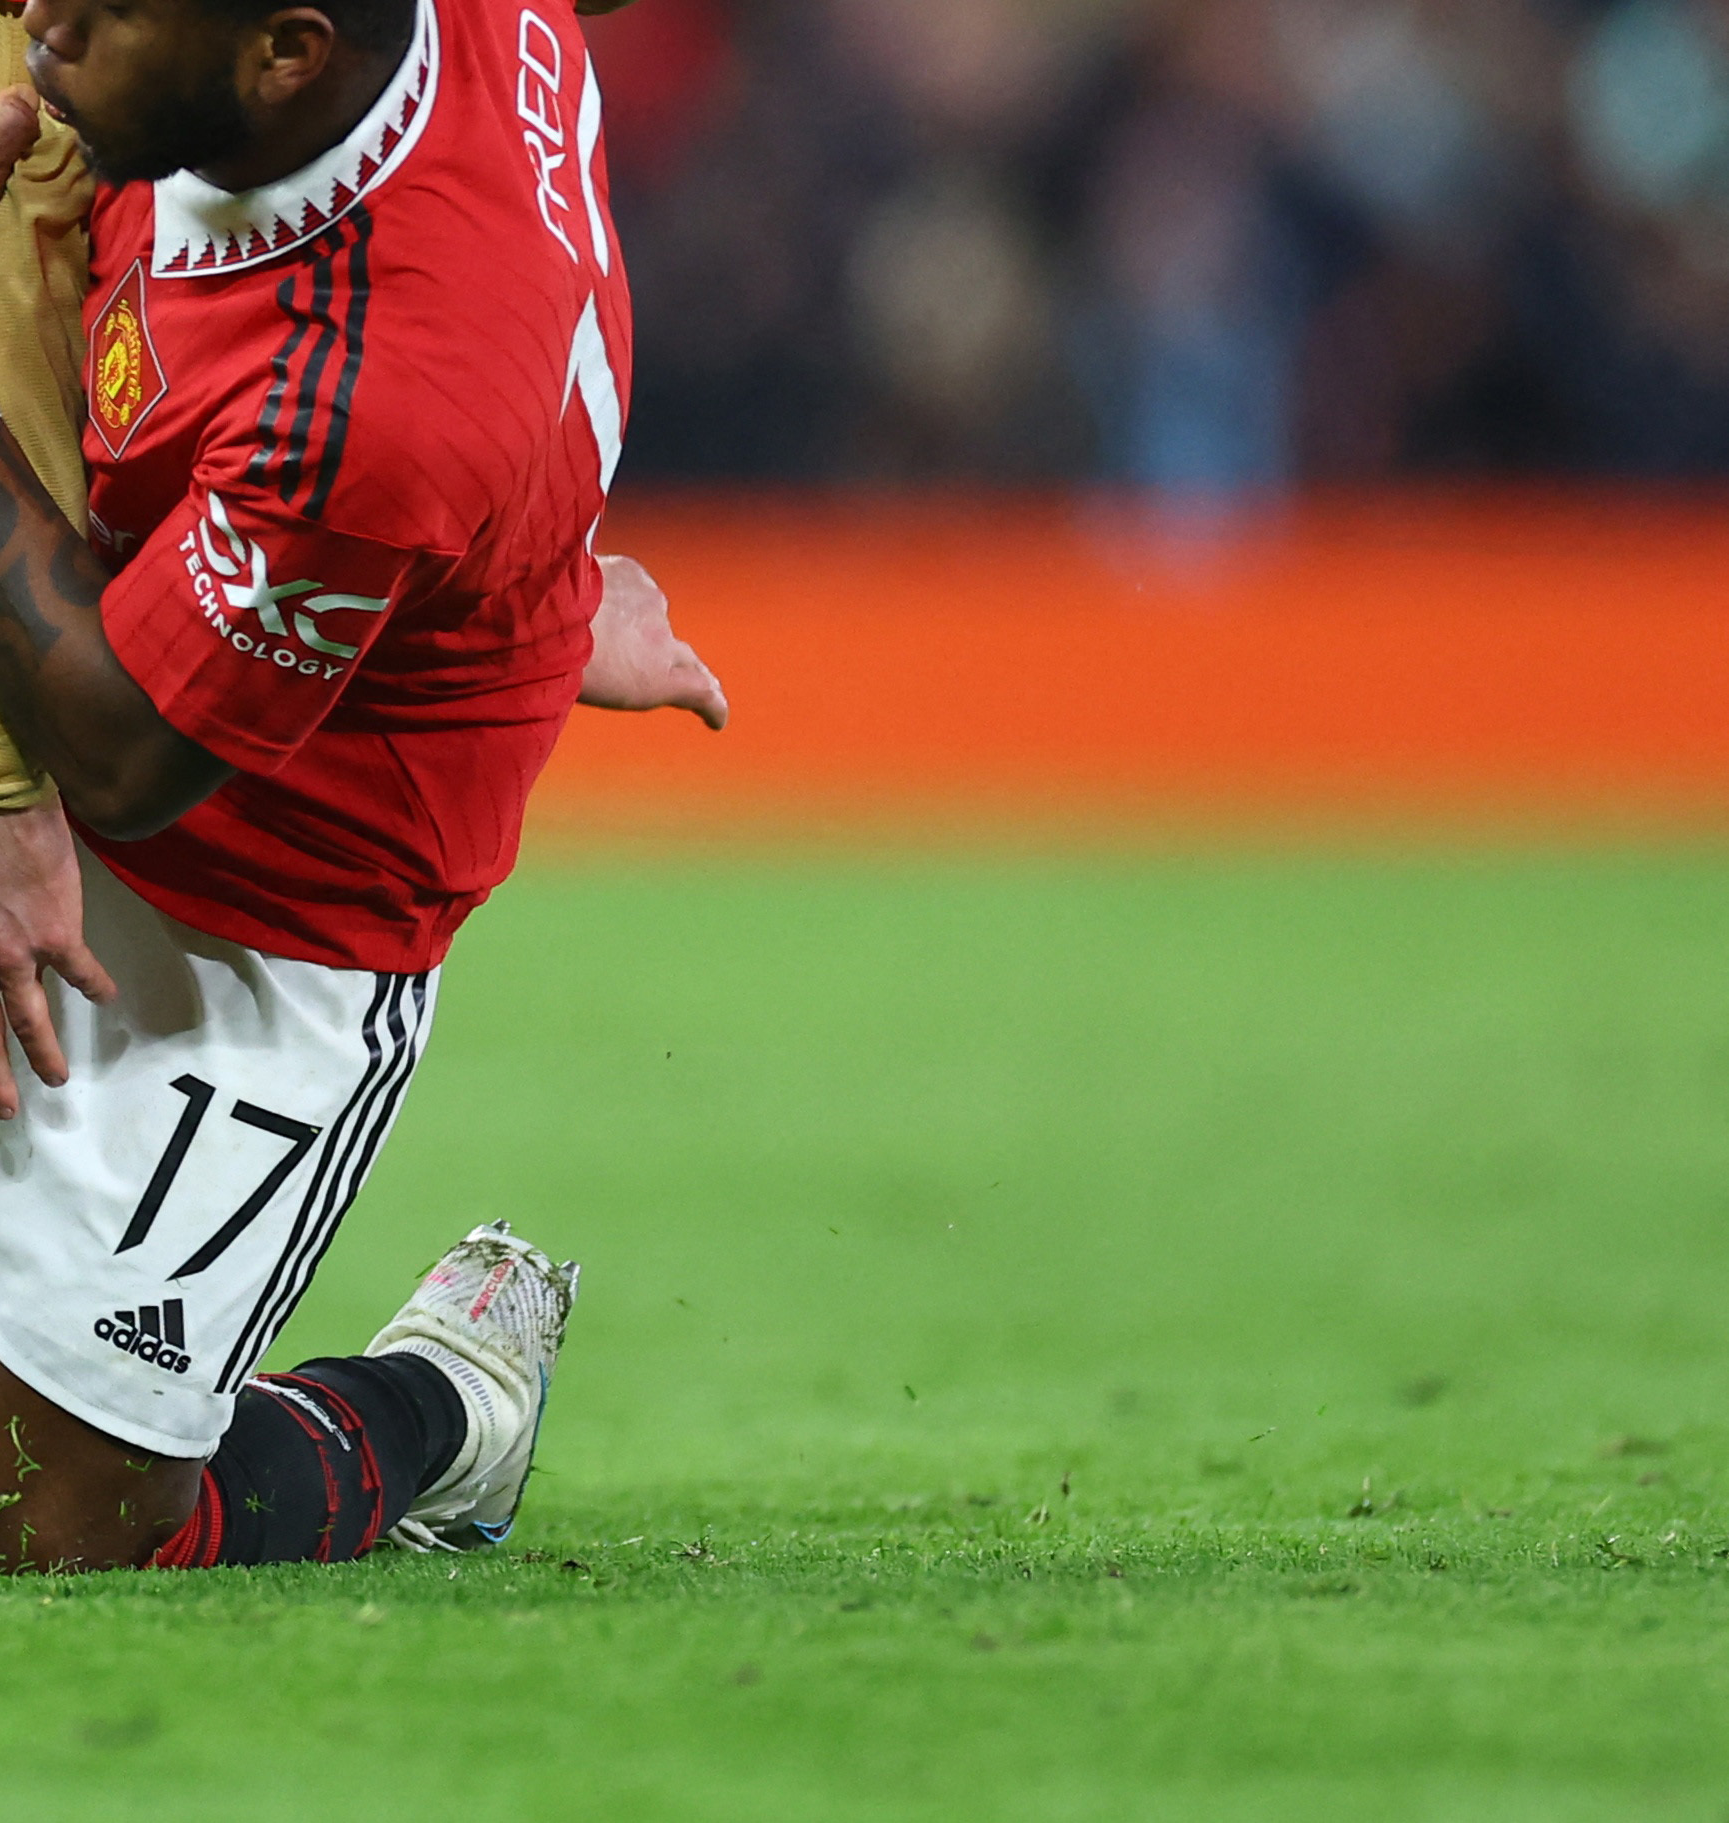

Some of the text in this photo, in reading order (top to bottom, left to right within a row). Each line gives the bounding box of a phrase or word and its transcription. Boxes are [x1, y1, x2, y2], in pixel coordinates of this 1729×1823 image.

[516, 7, 580, 266] FRED
[178, 530, 344, 681] TECHNOLOGY
[197, 489, 391, 660] DXC
[112, 1072, 324, 1282] 17
[93, 1316, 193, 1375] adidas
